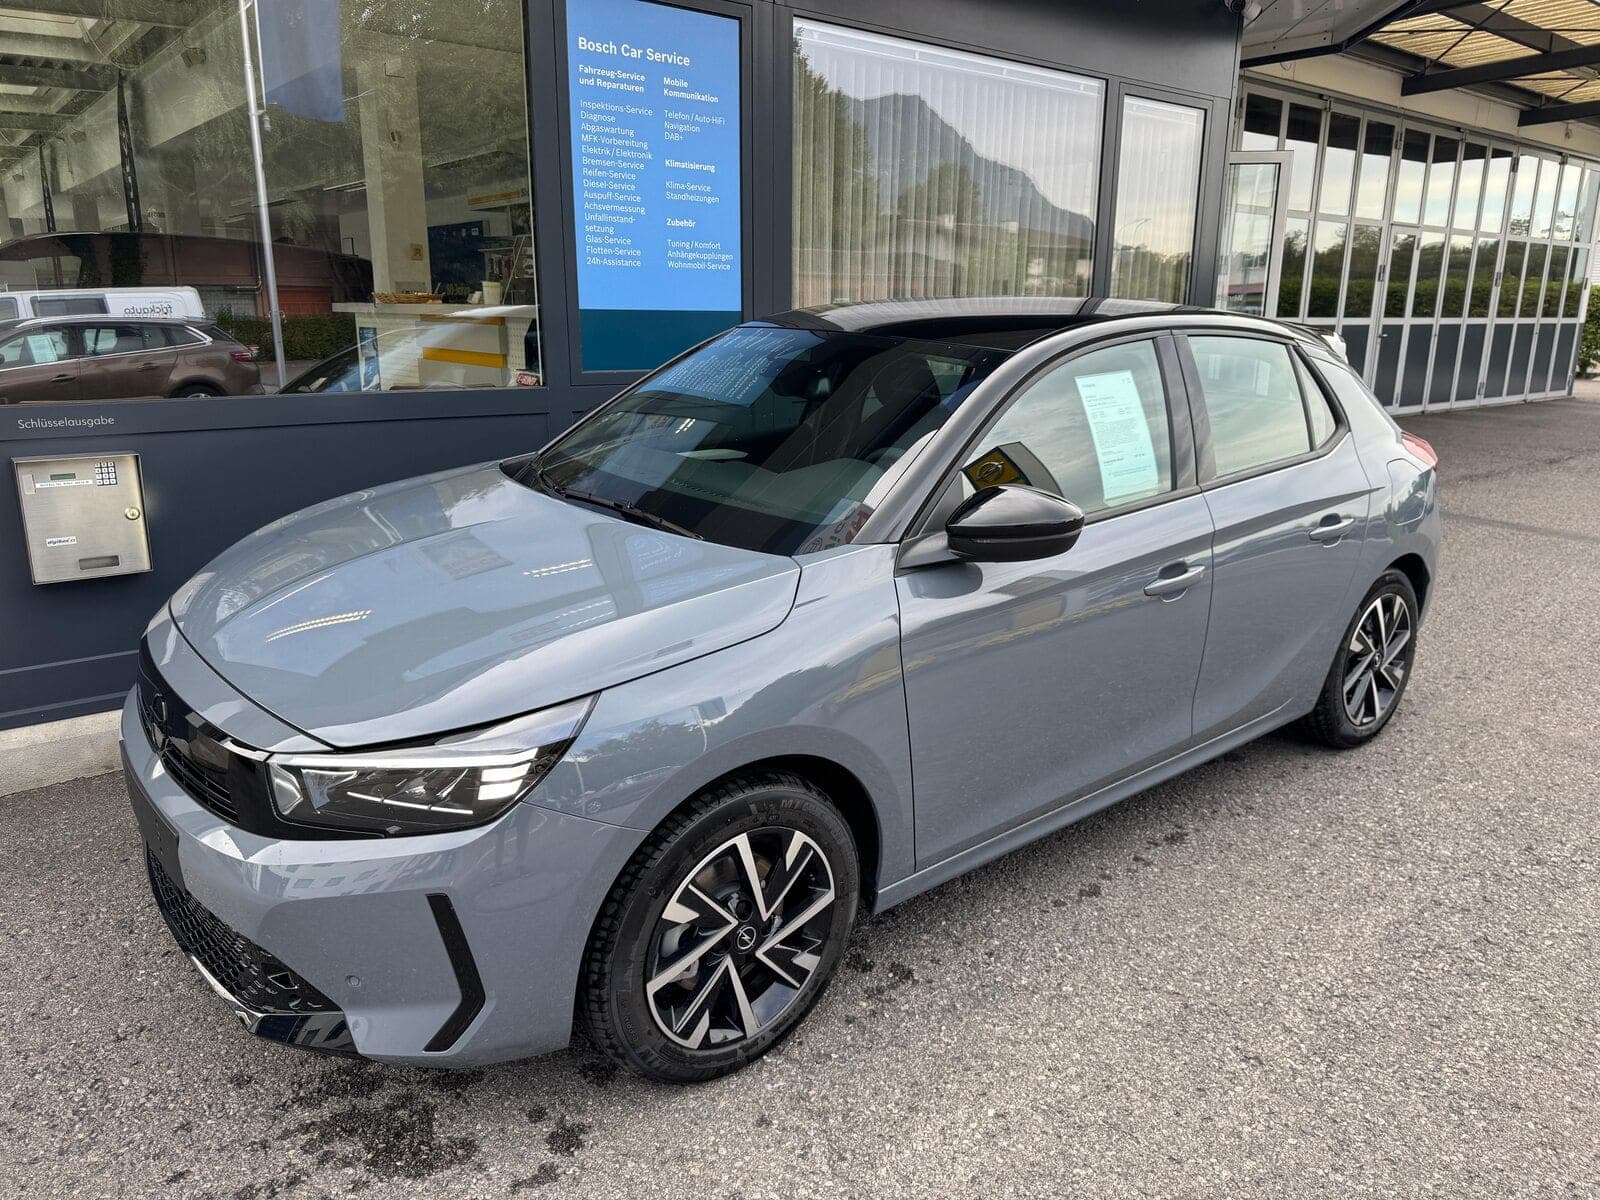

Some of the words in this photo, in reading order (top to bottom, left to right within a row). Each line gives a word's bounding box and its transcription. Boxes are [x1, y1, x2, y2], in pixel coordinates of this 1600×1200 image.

[578, 36, 617, 55] Bosch
[621, 44, 643, 59] Car
[646, 48, 691, 67] Service
[579, 64, 646, 82] Fahrzeug-Service
[579, 76, 595, 87] und
[596, 79, 645, 93] Reparaturen
[663, 76, 689, 88] Mobile
[663, 87, 719, 103] Kommunikation
[580, 99, 653, 116] Inspektions-Service
[580, 111, 616, 122] Diagnose
[664, 109, 690, 121] Telefon
[581, 122, 635, 138] Abgaswartung
[664, 120, 700, 133] Navigation
[581, 133, 648, 150] MFK-Vorbereitung
[664, 131, 683, 141] DAB+
[615, 148, 653, 160] Elektronik
[582, 156, 645, 170] Bremsen-Service
[665, 159, 716, 173] Klimatisierung
[582, 167, 636, 180] Reifen-Service
[583, 179, 636, 191] Diesel-Service
[665, 181, 712, 193] Klima-Service
[583, 190, 641, 203] Auspuff-Service
[665, 191, 720, 204] Standheizungen
[584, 201, 646, 215] Achsvermessung
[584, 212, 636, 224] Unfallinstand-
[666, 217, 696, 229] Zubehör
[584, 225, 615, 235] setzung
[585, 234, 632, 245] Glas-Service
[667, 239, 690, 250] Tuning
[694, 240, 721, 251] Komfort
[586, 245, 641, 257] Flotten-Service
[667, 250, 734, 262] Anhängekupplungen
[586, 256, 641, 267] 24h-Assistance
[667, 260, 731, 271] Wohnmobil-Service
[17, 415, 116, 430] Schlüsselausgabe
